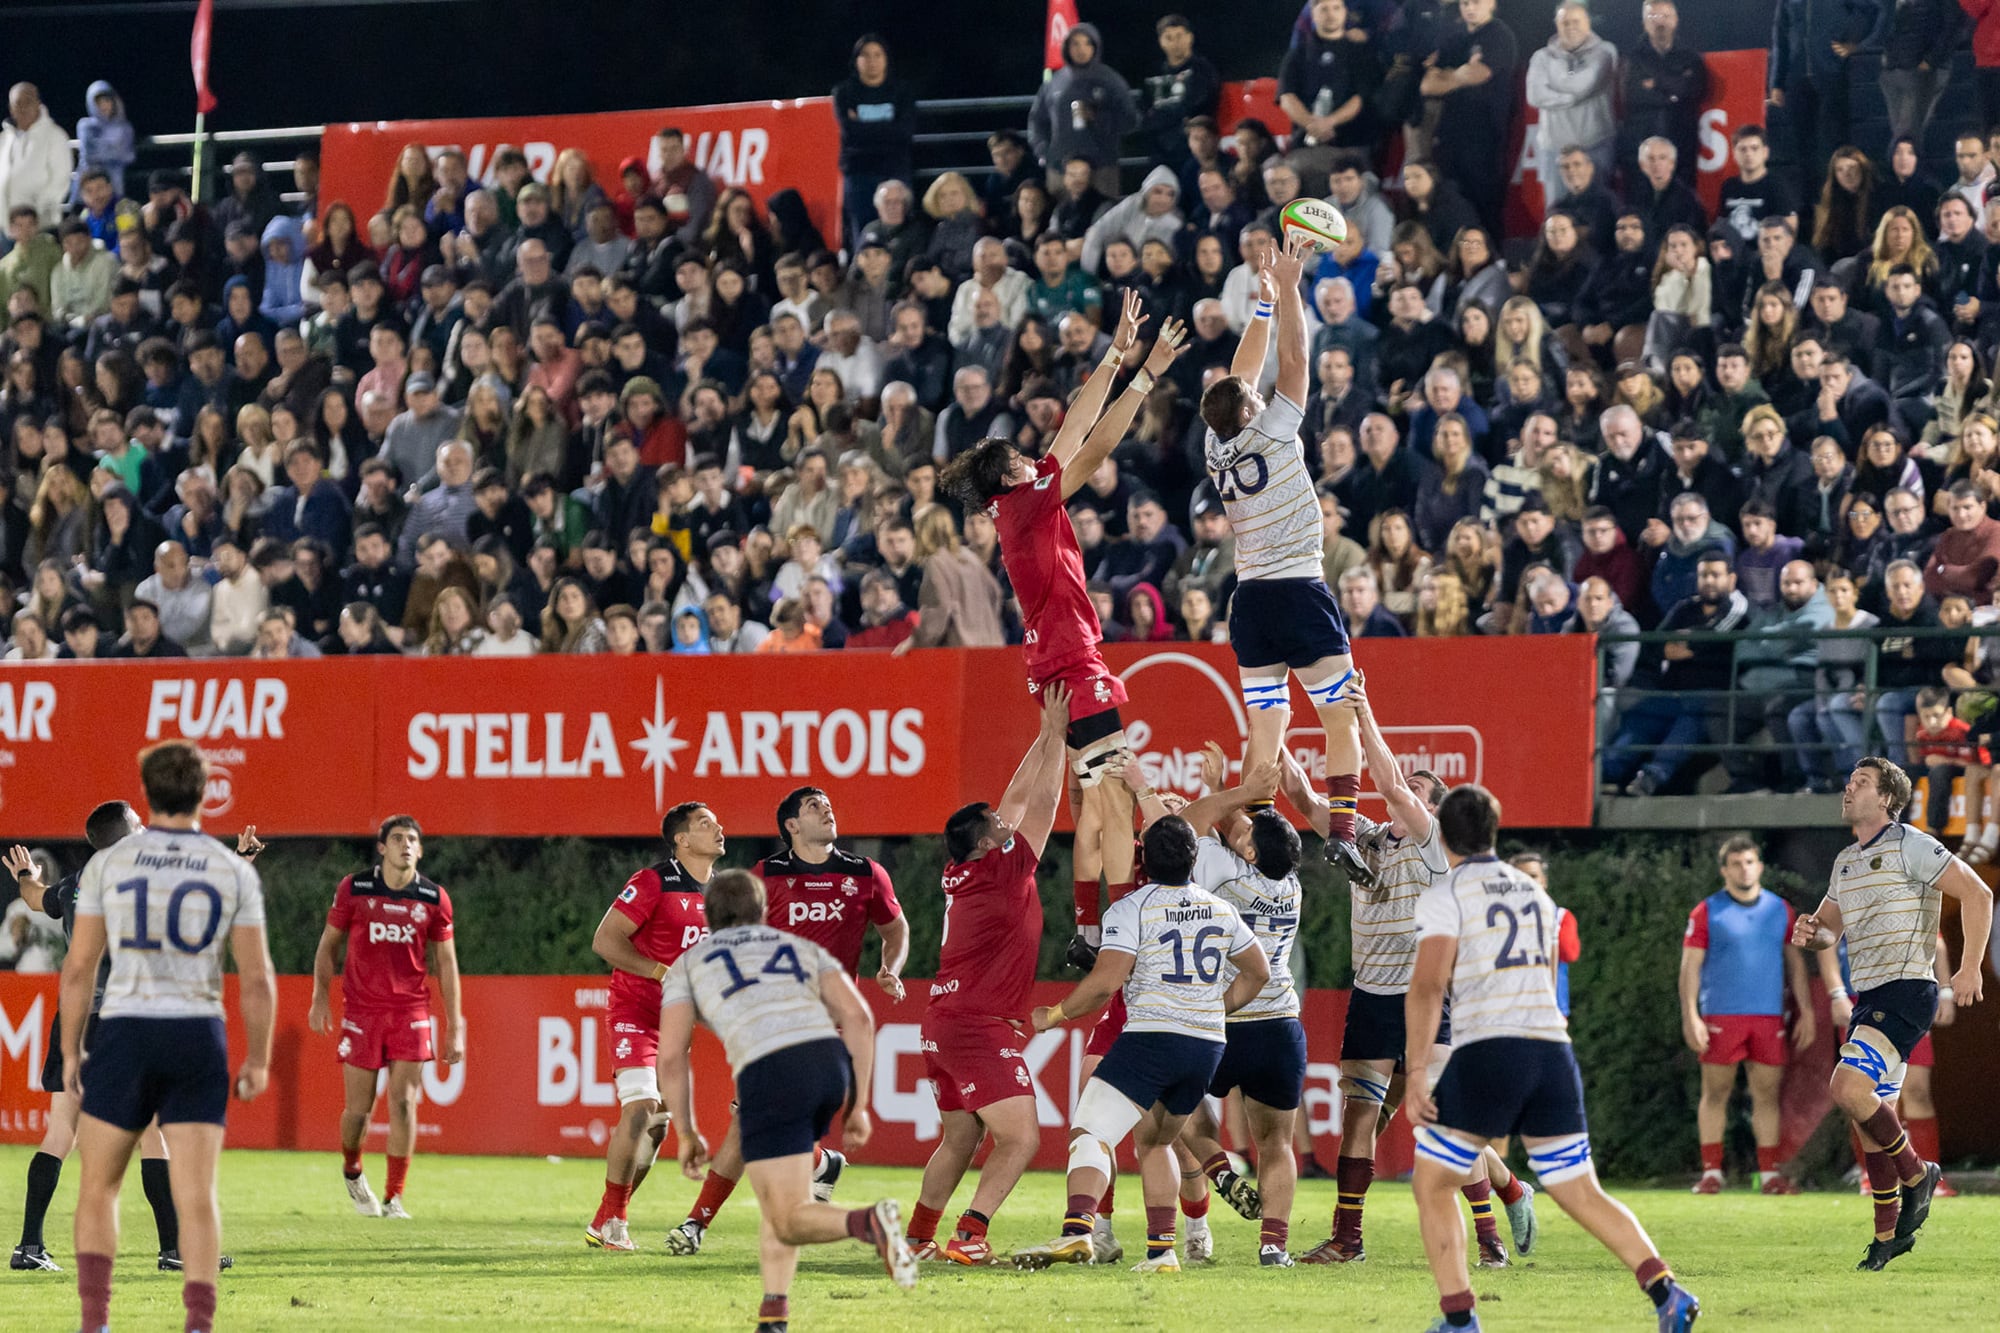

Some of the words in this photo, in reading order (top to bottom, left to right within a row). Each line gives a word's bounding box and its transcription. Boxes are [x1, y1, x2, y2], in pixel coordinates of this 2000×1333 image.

[146, 678, 288, 739] FUAR
[407, 711, 625, 779] STELLA
[693, 708, 926, 777] ARTOIS
[1295, 747, 1326, 779] Pla
[133, 850, 209, 872] Imperial
[116, 875, 222, 954] 10
[369, 921, 417, 944] pax
[681, 925, 712, 949] pa
[788, 899, 846, 926] pax
[1164, 905, 1213, 925] Imperial
[1486, 901, 1549, 970] 21
[703, 943, 812, 999] 14
[1158, 925, 1225, 984] 16
[538, 1016, 616, 1107] BL
